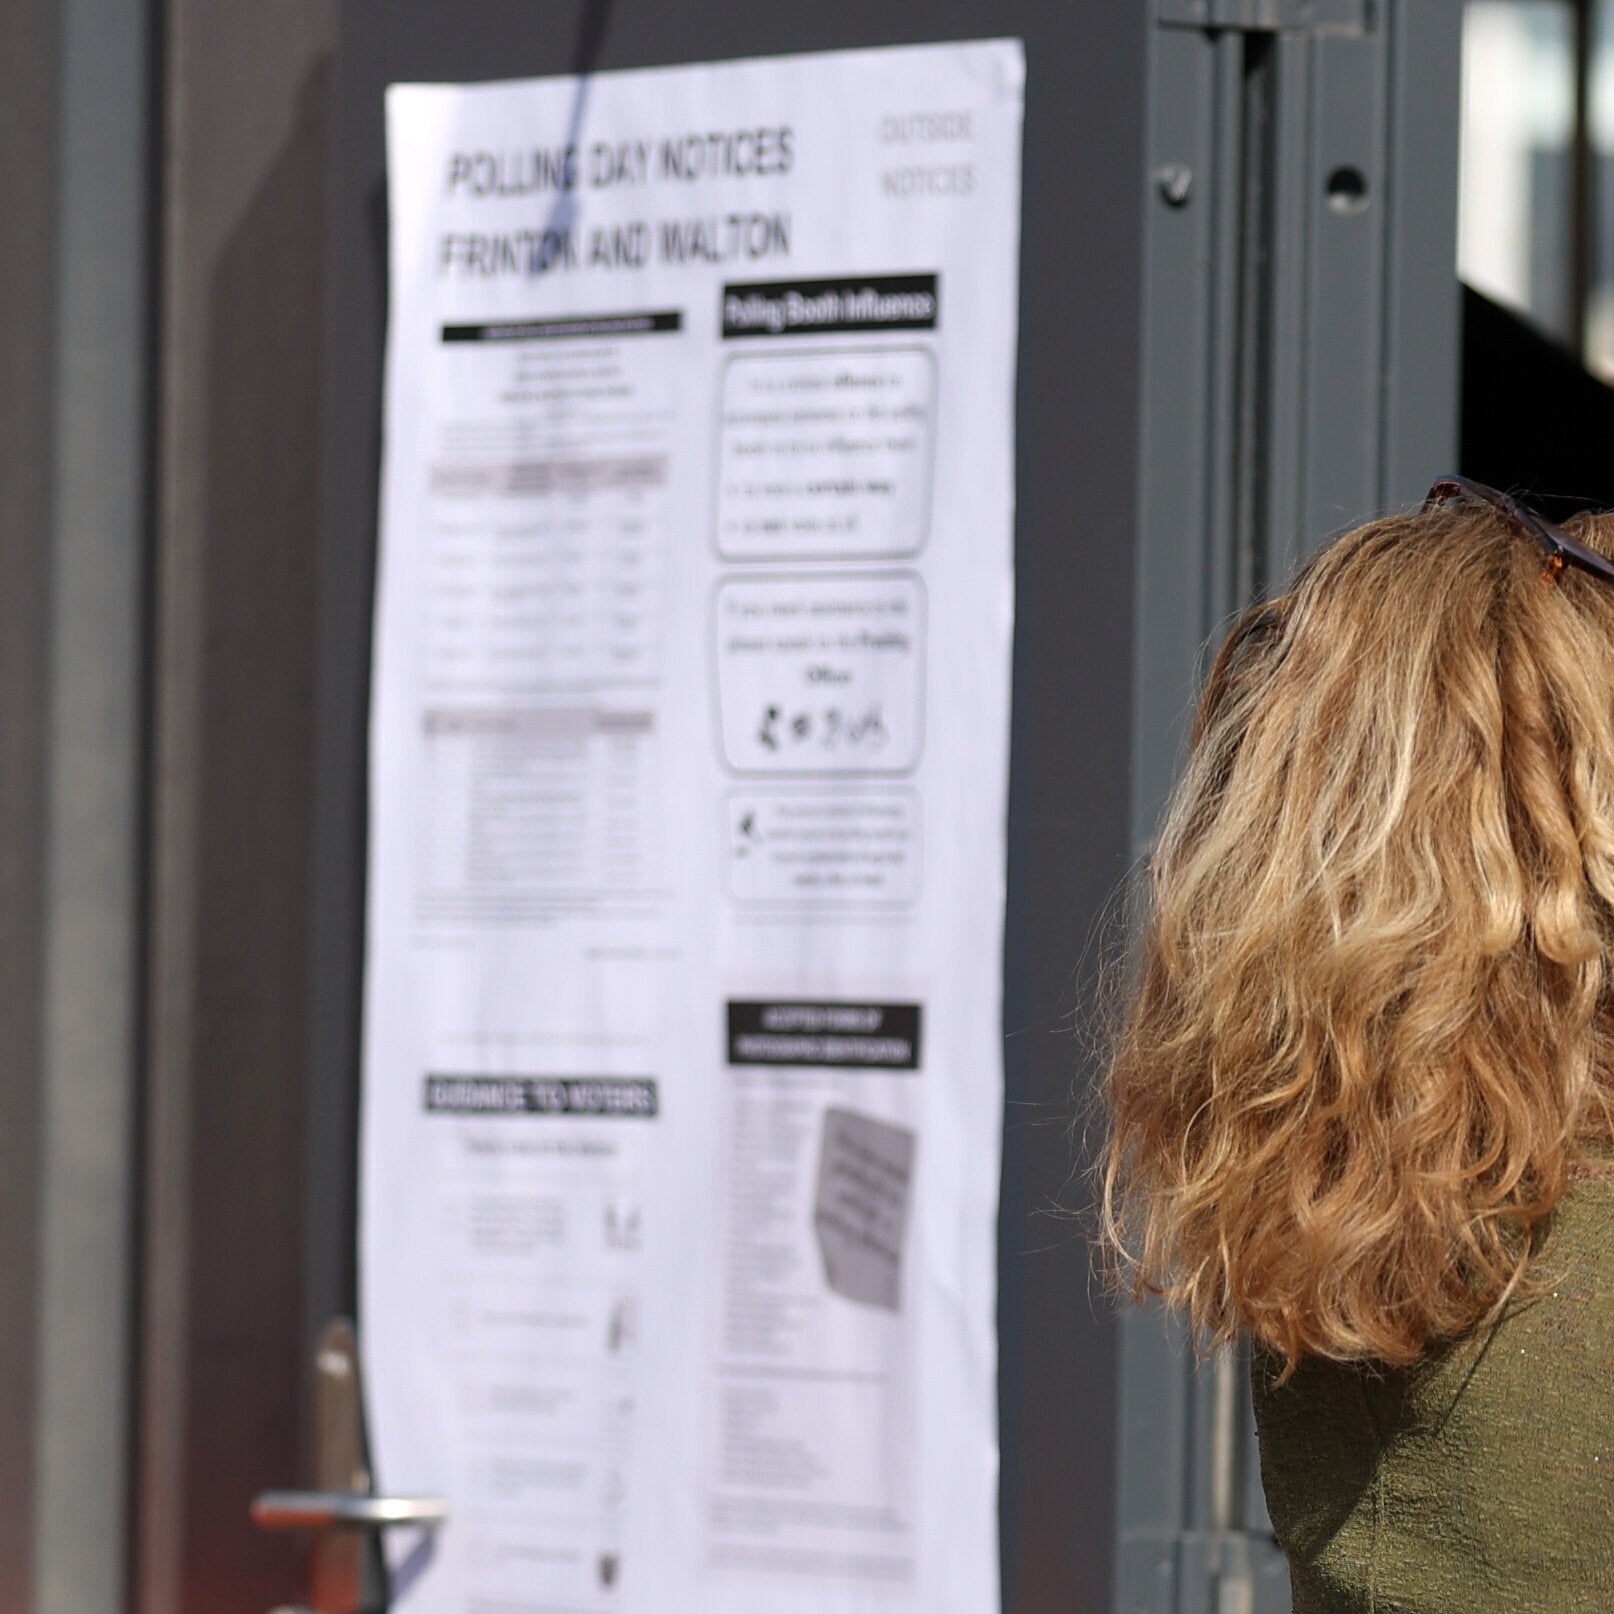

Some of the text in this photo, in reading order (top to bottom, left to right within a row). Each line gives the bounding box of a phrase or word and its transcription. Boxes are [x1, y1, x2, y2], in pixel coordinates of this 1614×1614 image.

[881, 110, 974, 144] OUTSIDE
[447, 126, 795, 197] POLLING DAY NOTICES
[881, 164, 976, 198] NOTICES
[440, 212, 792, 280] FRINTON AND WALTON
